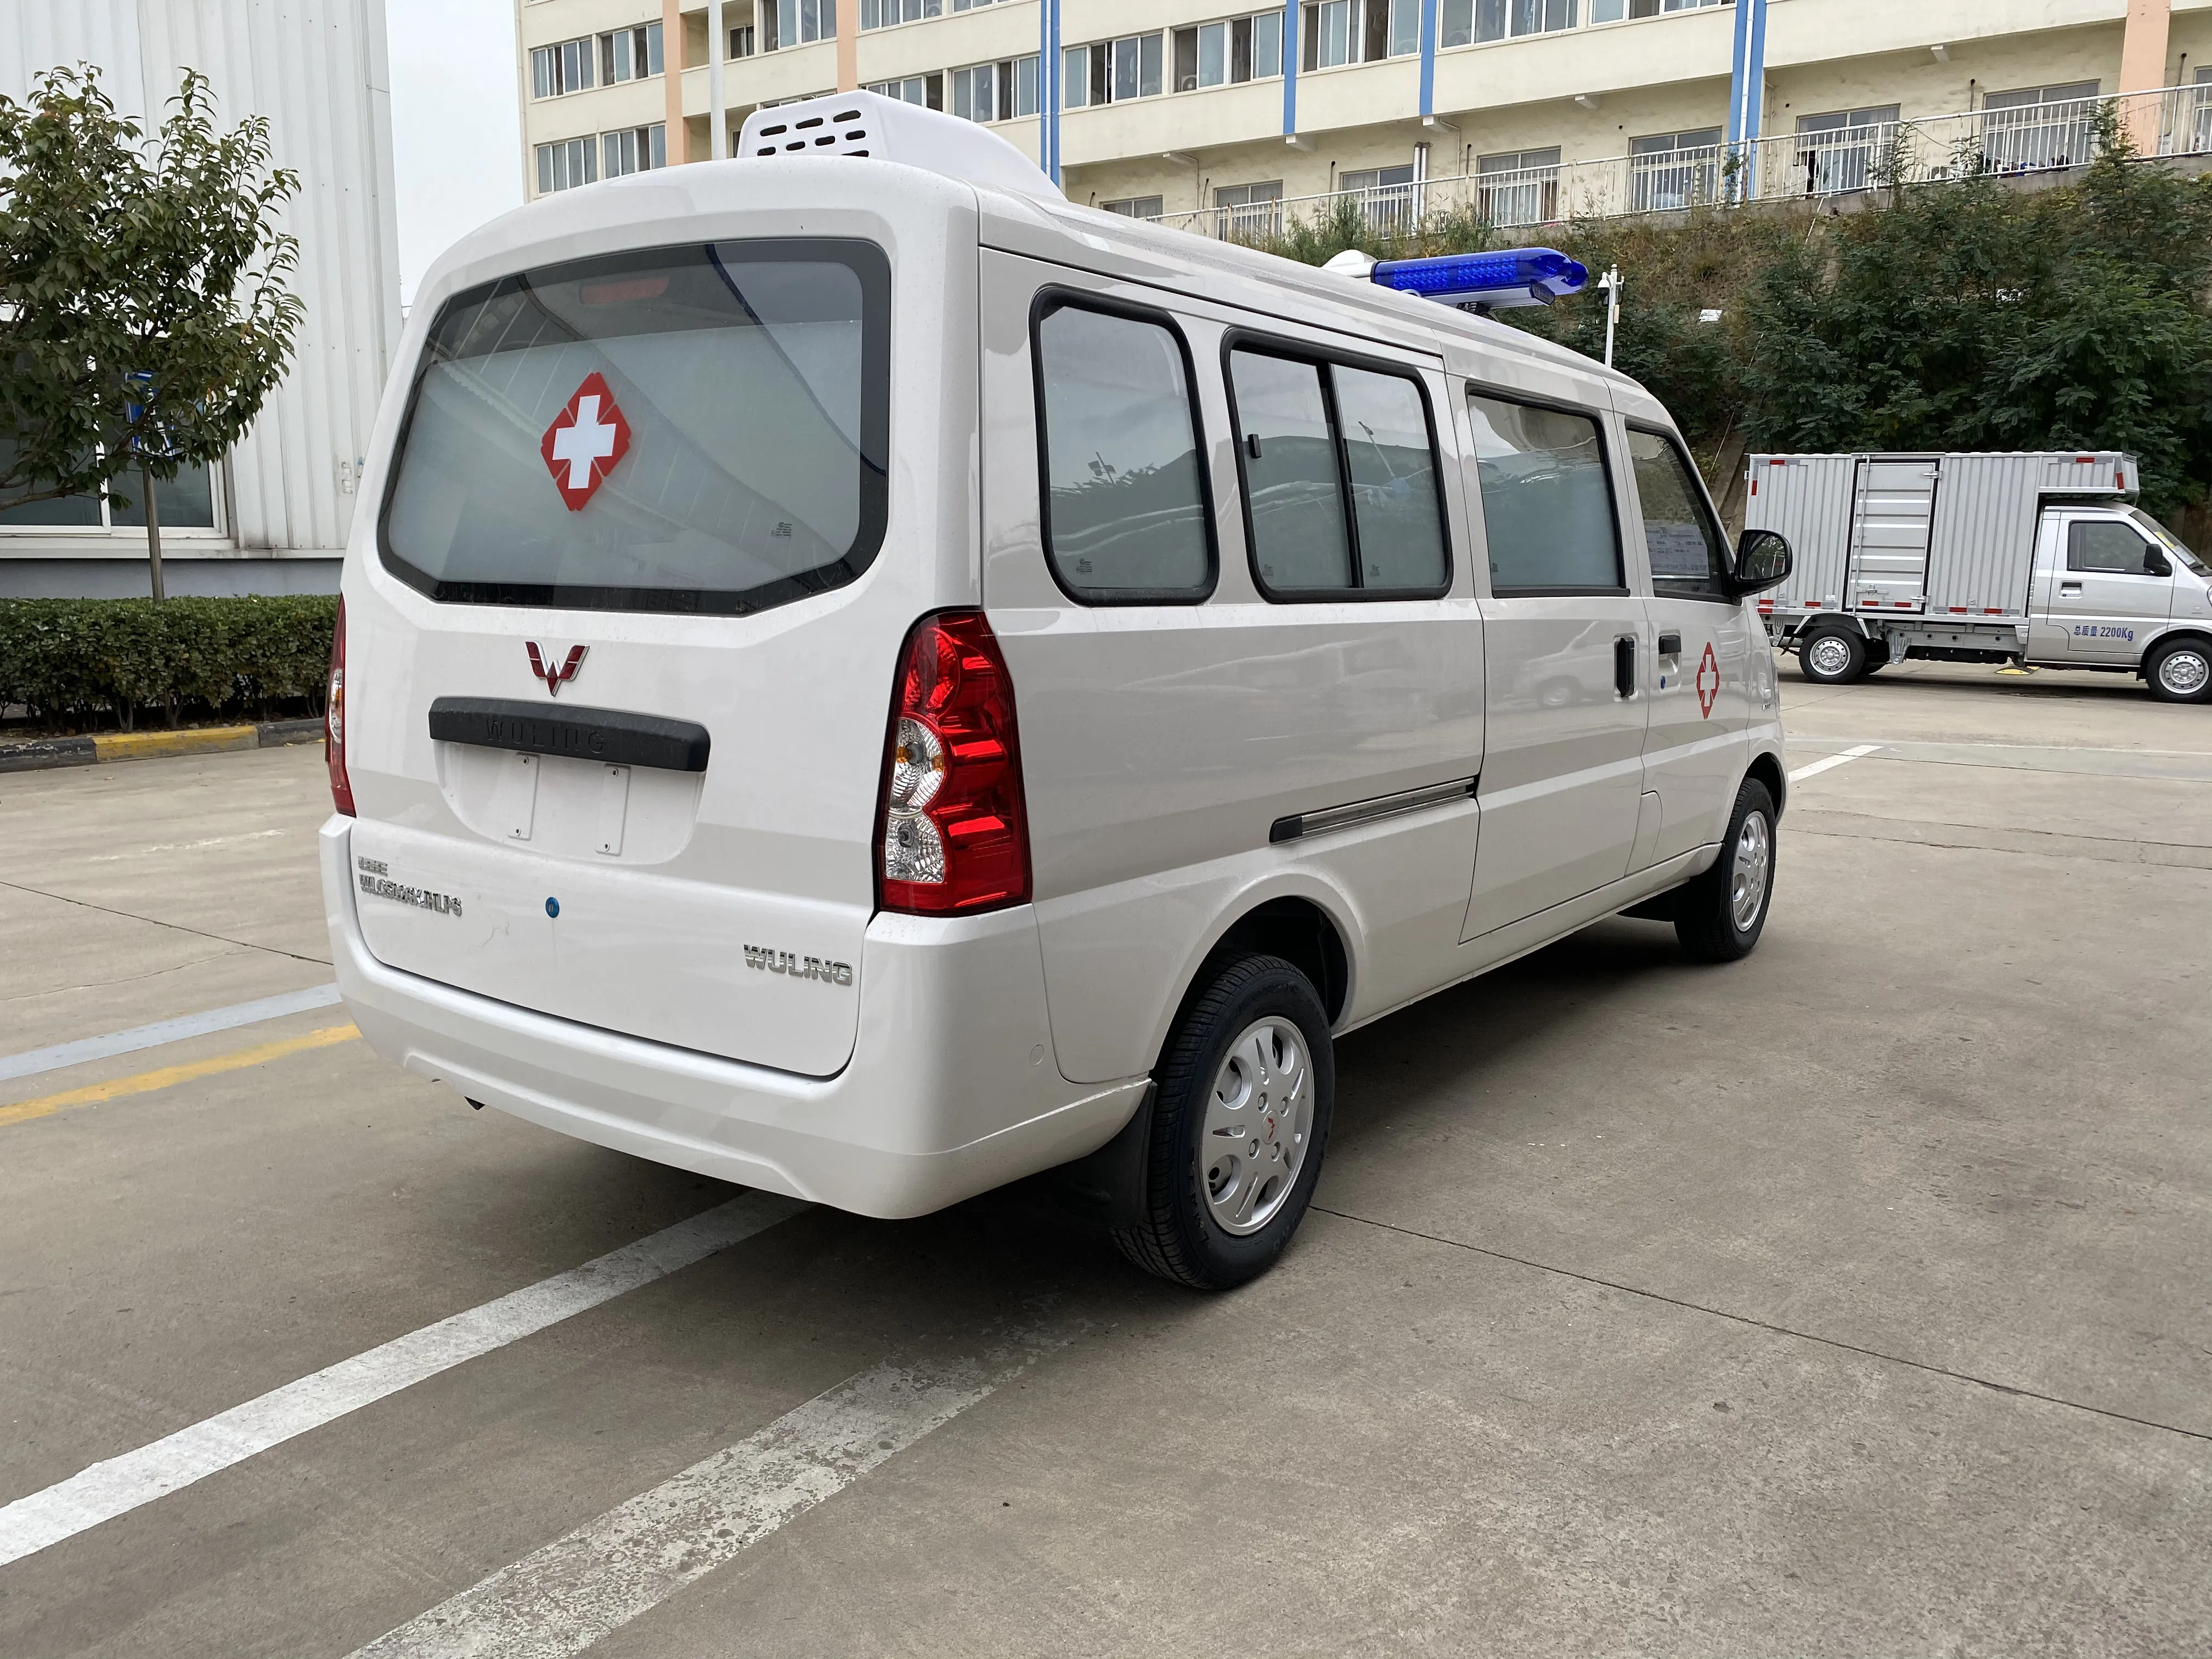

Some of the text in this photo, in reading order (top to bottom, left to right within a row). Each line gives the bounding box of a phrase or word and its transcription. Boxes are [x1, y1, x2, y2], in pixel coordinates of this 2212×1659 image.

[2074, 625, 2134, 641] 总质量 2200Kg
[486, 720, 604, 754] WULING
[743, 944, 852, 986] WULING
